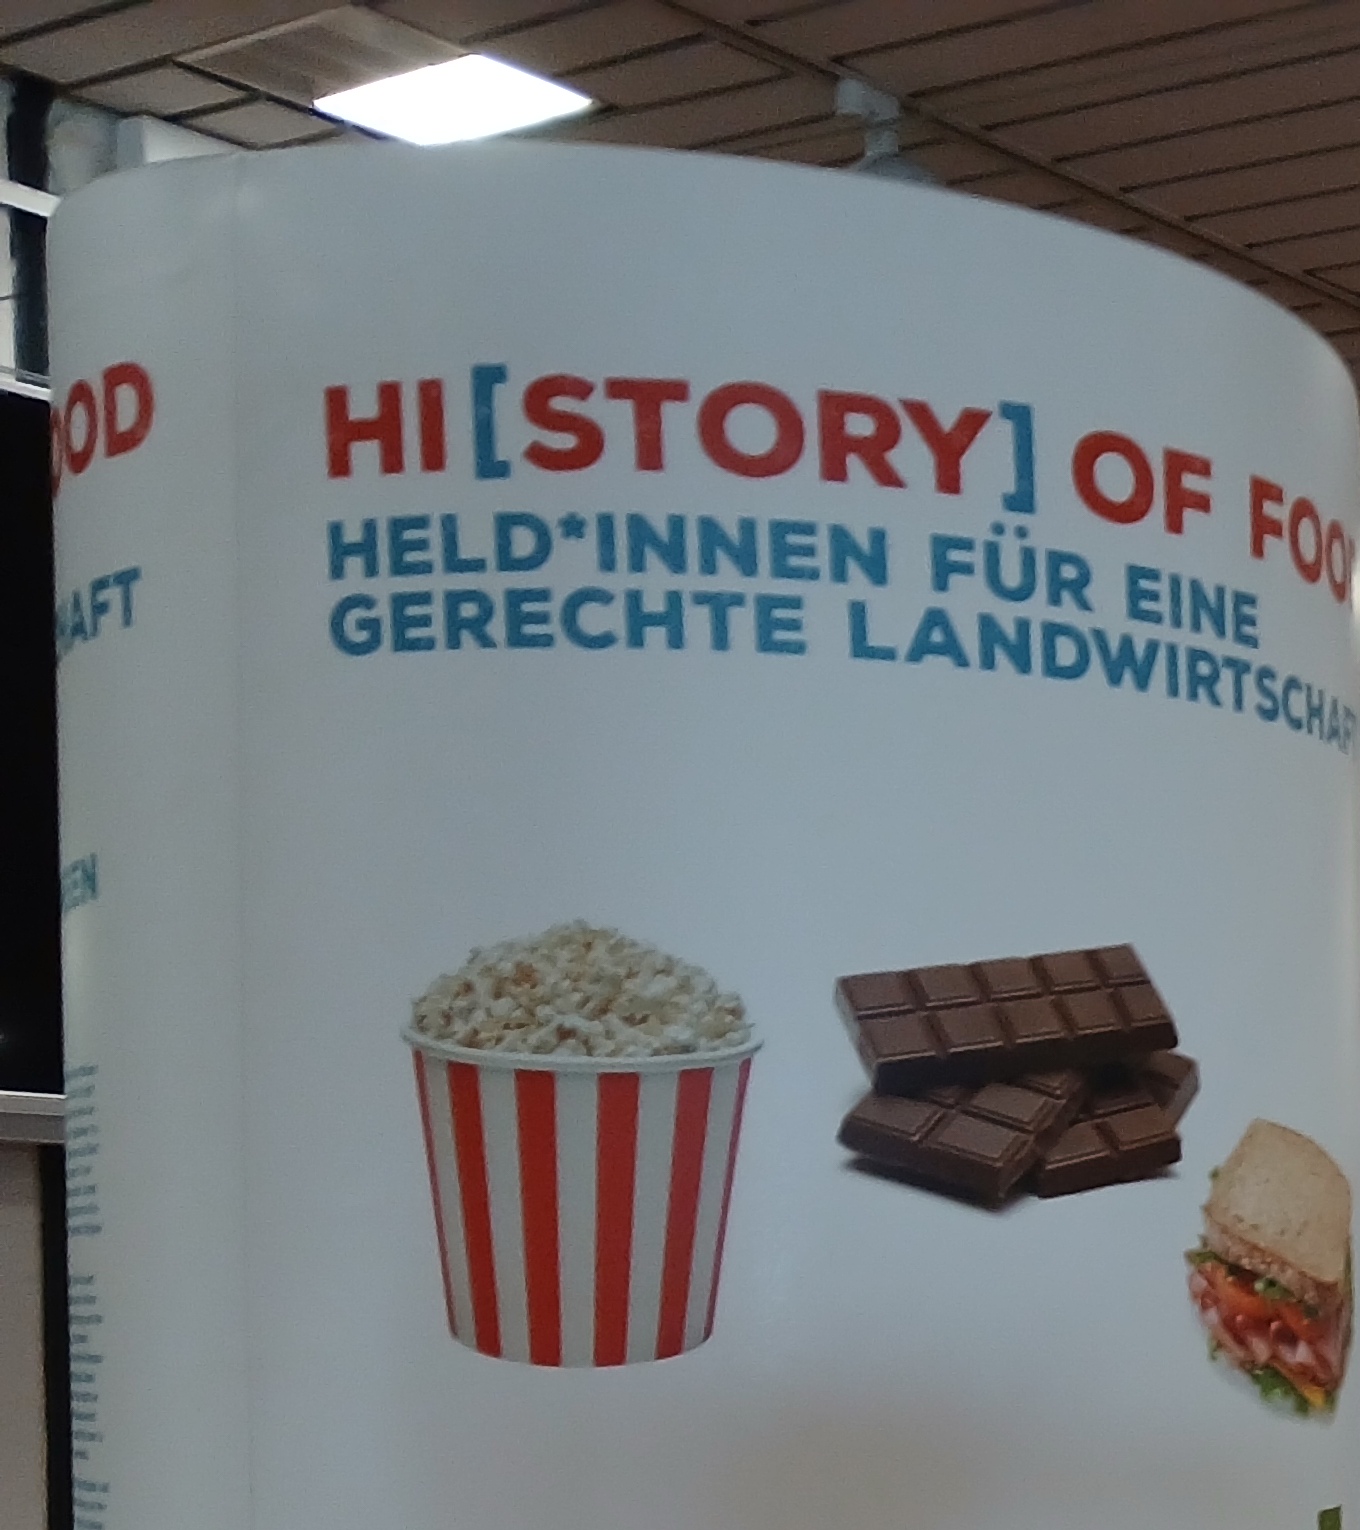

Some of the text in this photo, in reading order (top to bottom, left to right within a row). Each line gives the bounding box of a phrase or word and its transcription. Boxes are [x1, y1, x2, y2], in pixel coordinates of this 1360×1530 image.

[324, 364, 1354, 605] HI[STORY] OF FOO
[329, 588, 808, 657] GERECHTE
[931, 520, 1094, 612] FÜR
[1126, 564, 1260, 649] EINE
